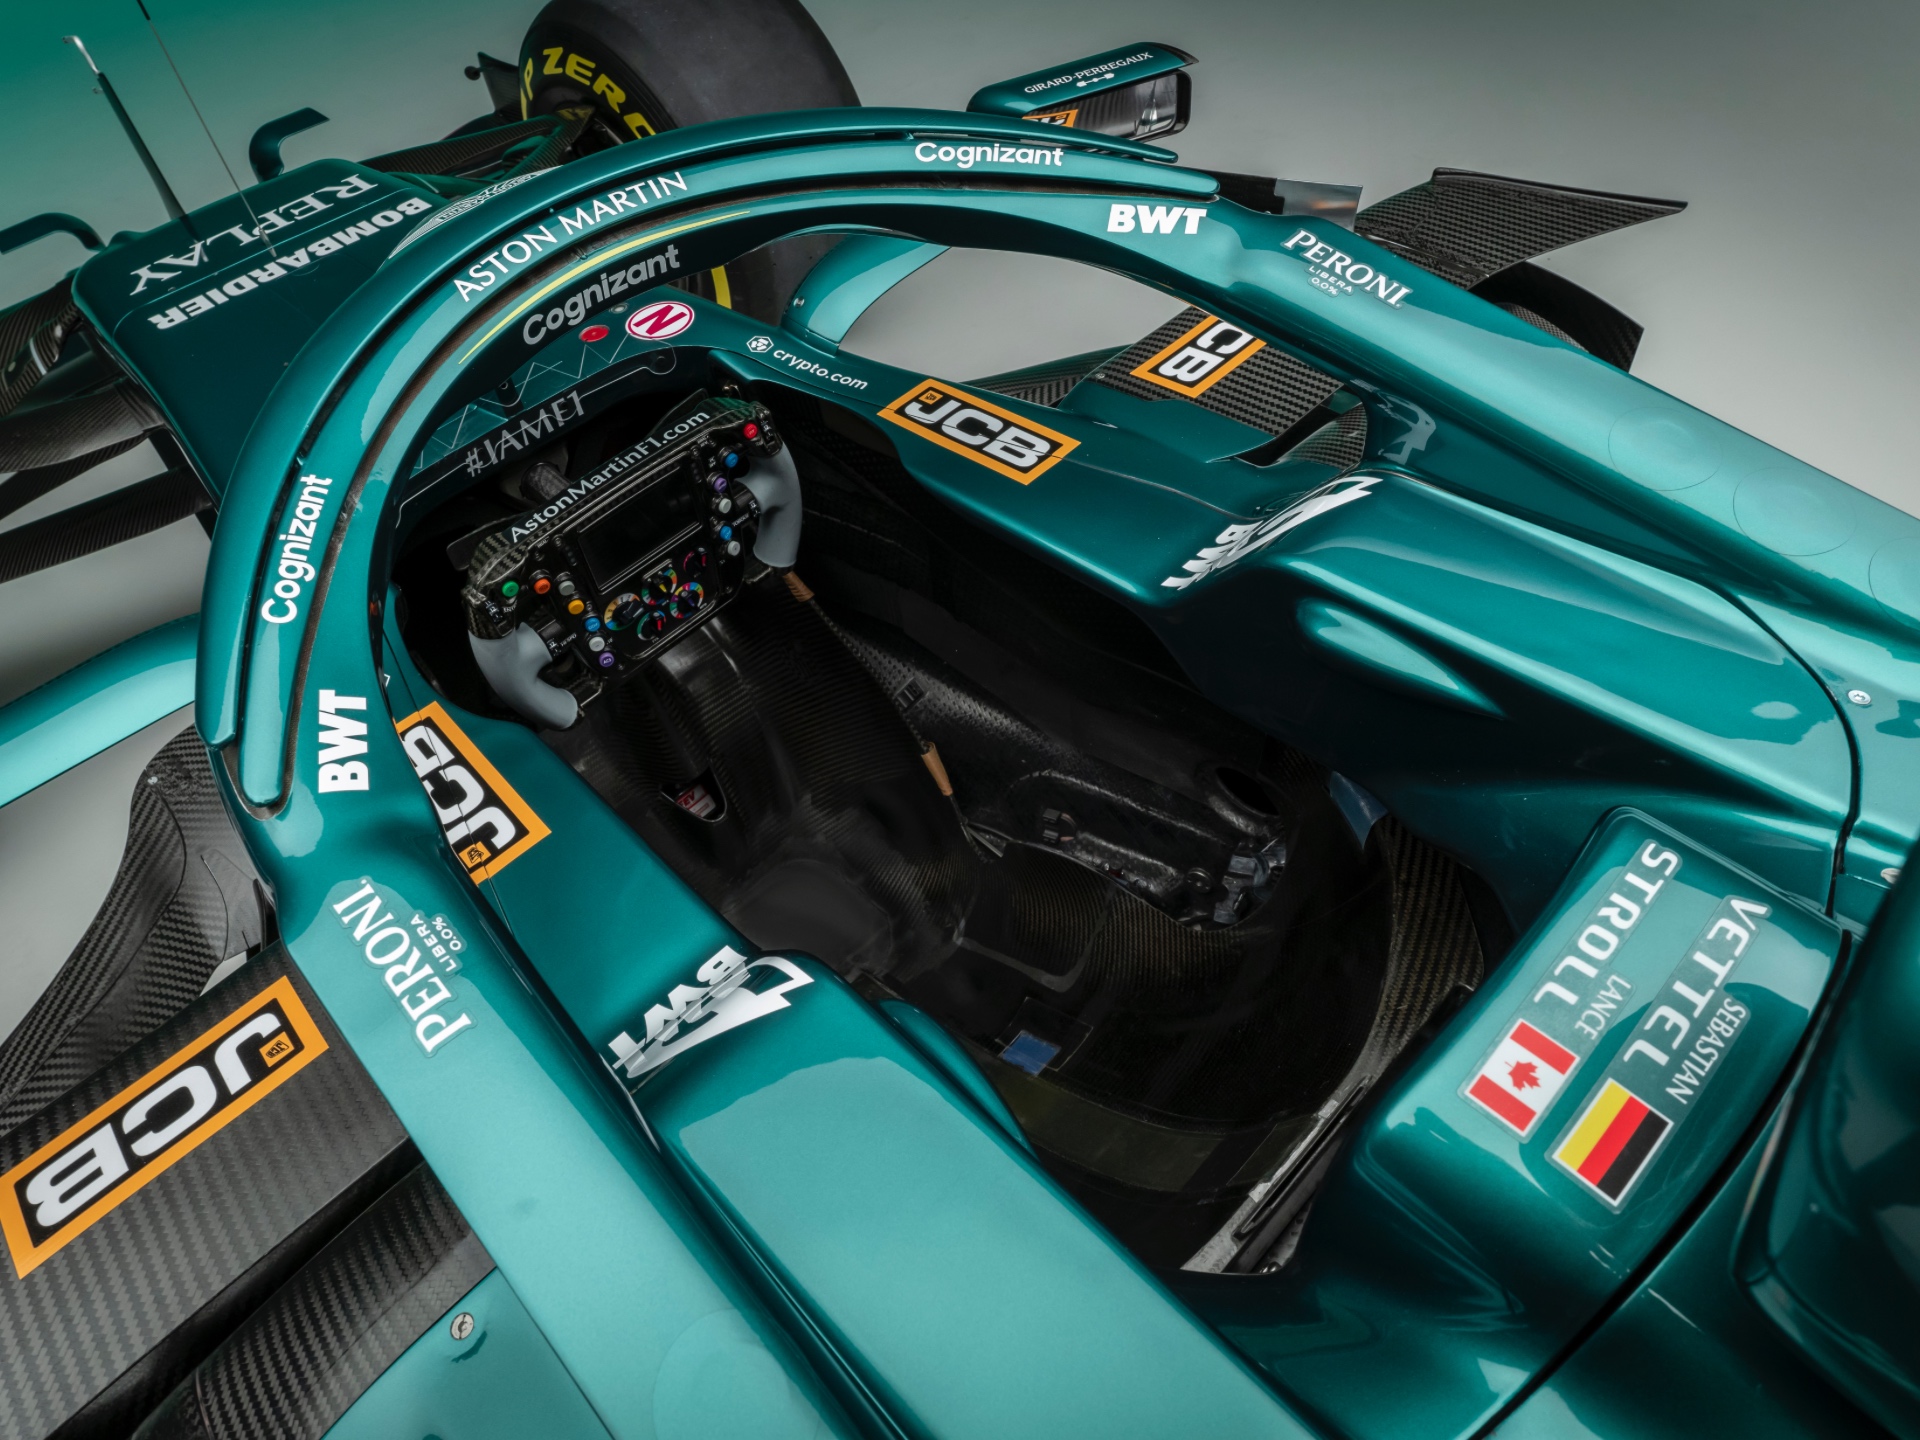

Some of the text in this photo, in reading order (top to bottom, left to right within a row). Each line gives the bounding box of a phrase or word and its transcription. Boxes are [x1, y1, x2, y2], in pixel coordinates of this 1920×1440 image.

[1024, 52, 1153, 94] GIRARD-PERREGAUX
[914, 141, 1064, 169] Cognizant
[130, 174, 378, 296] REPLAY
[147, 197, 432, 330] BOMBARDIER
[453, 225, 558, 302] ASTON
[558, 171, 688, 235] MARTIN
[1107, 204, 1207, 235] BWT
[523, 244, 681, 345] Cognizant
[1284, 229, 1412, 306] PERONI
[1308, 265, 1353, 293] LIBERA
[1311, 277, 1338, 295] 0.0%
[772, 347, 868, 391] crypto.com
[1158, 321, 1256, 383] CB
[509, 410, 710, 543] AstonMartinF1.com
[904, 396, 1052, 468] JCB
[261, 474, 333, 624] Cognizant
[318, 689, 369, 793] BWT
[333, 883, 472, 1053] PERONI
[410, 914, 457, 972] LIBERA
[432, 916, 461, 951] 0.0%
[1533, 843, 1679, 1005] STROLL
[1574, 974, 1631, 1041] LANCE
[1623, 898, 1768, 1066] VETTEL
[1666, 997, 1747, 1105] SEBASTIAN
[26, 1012, 283, 1228] JCB
